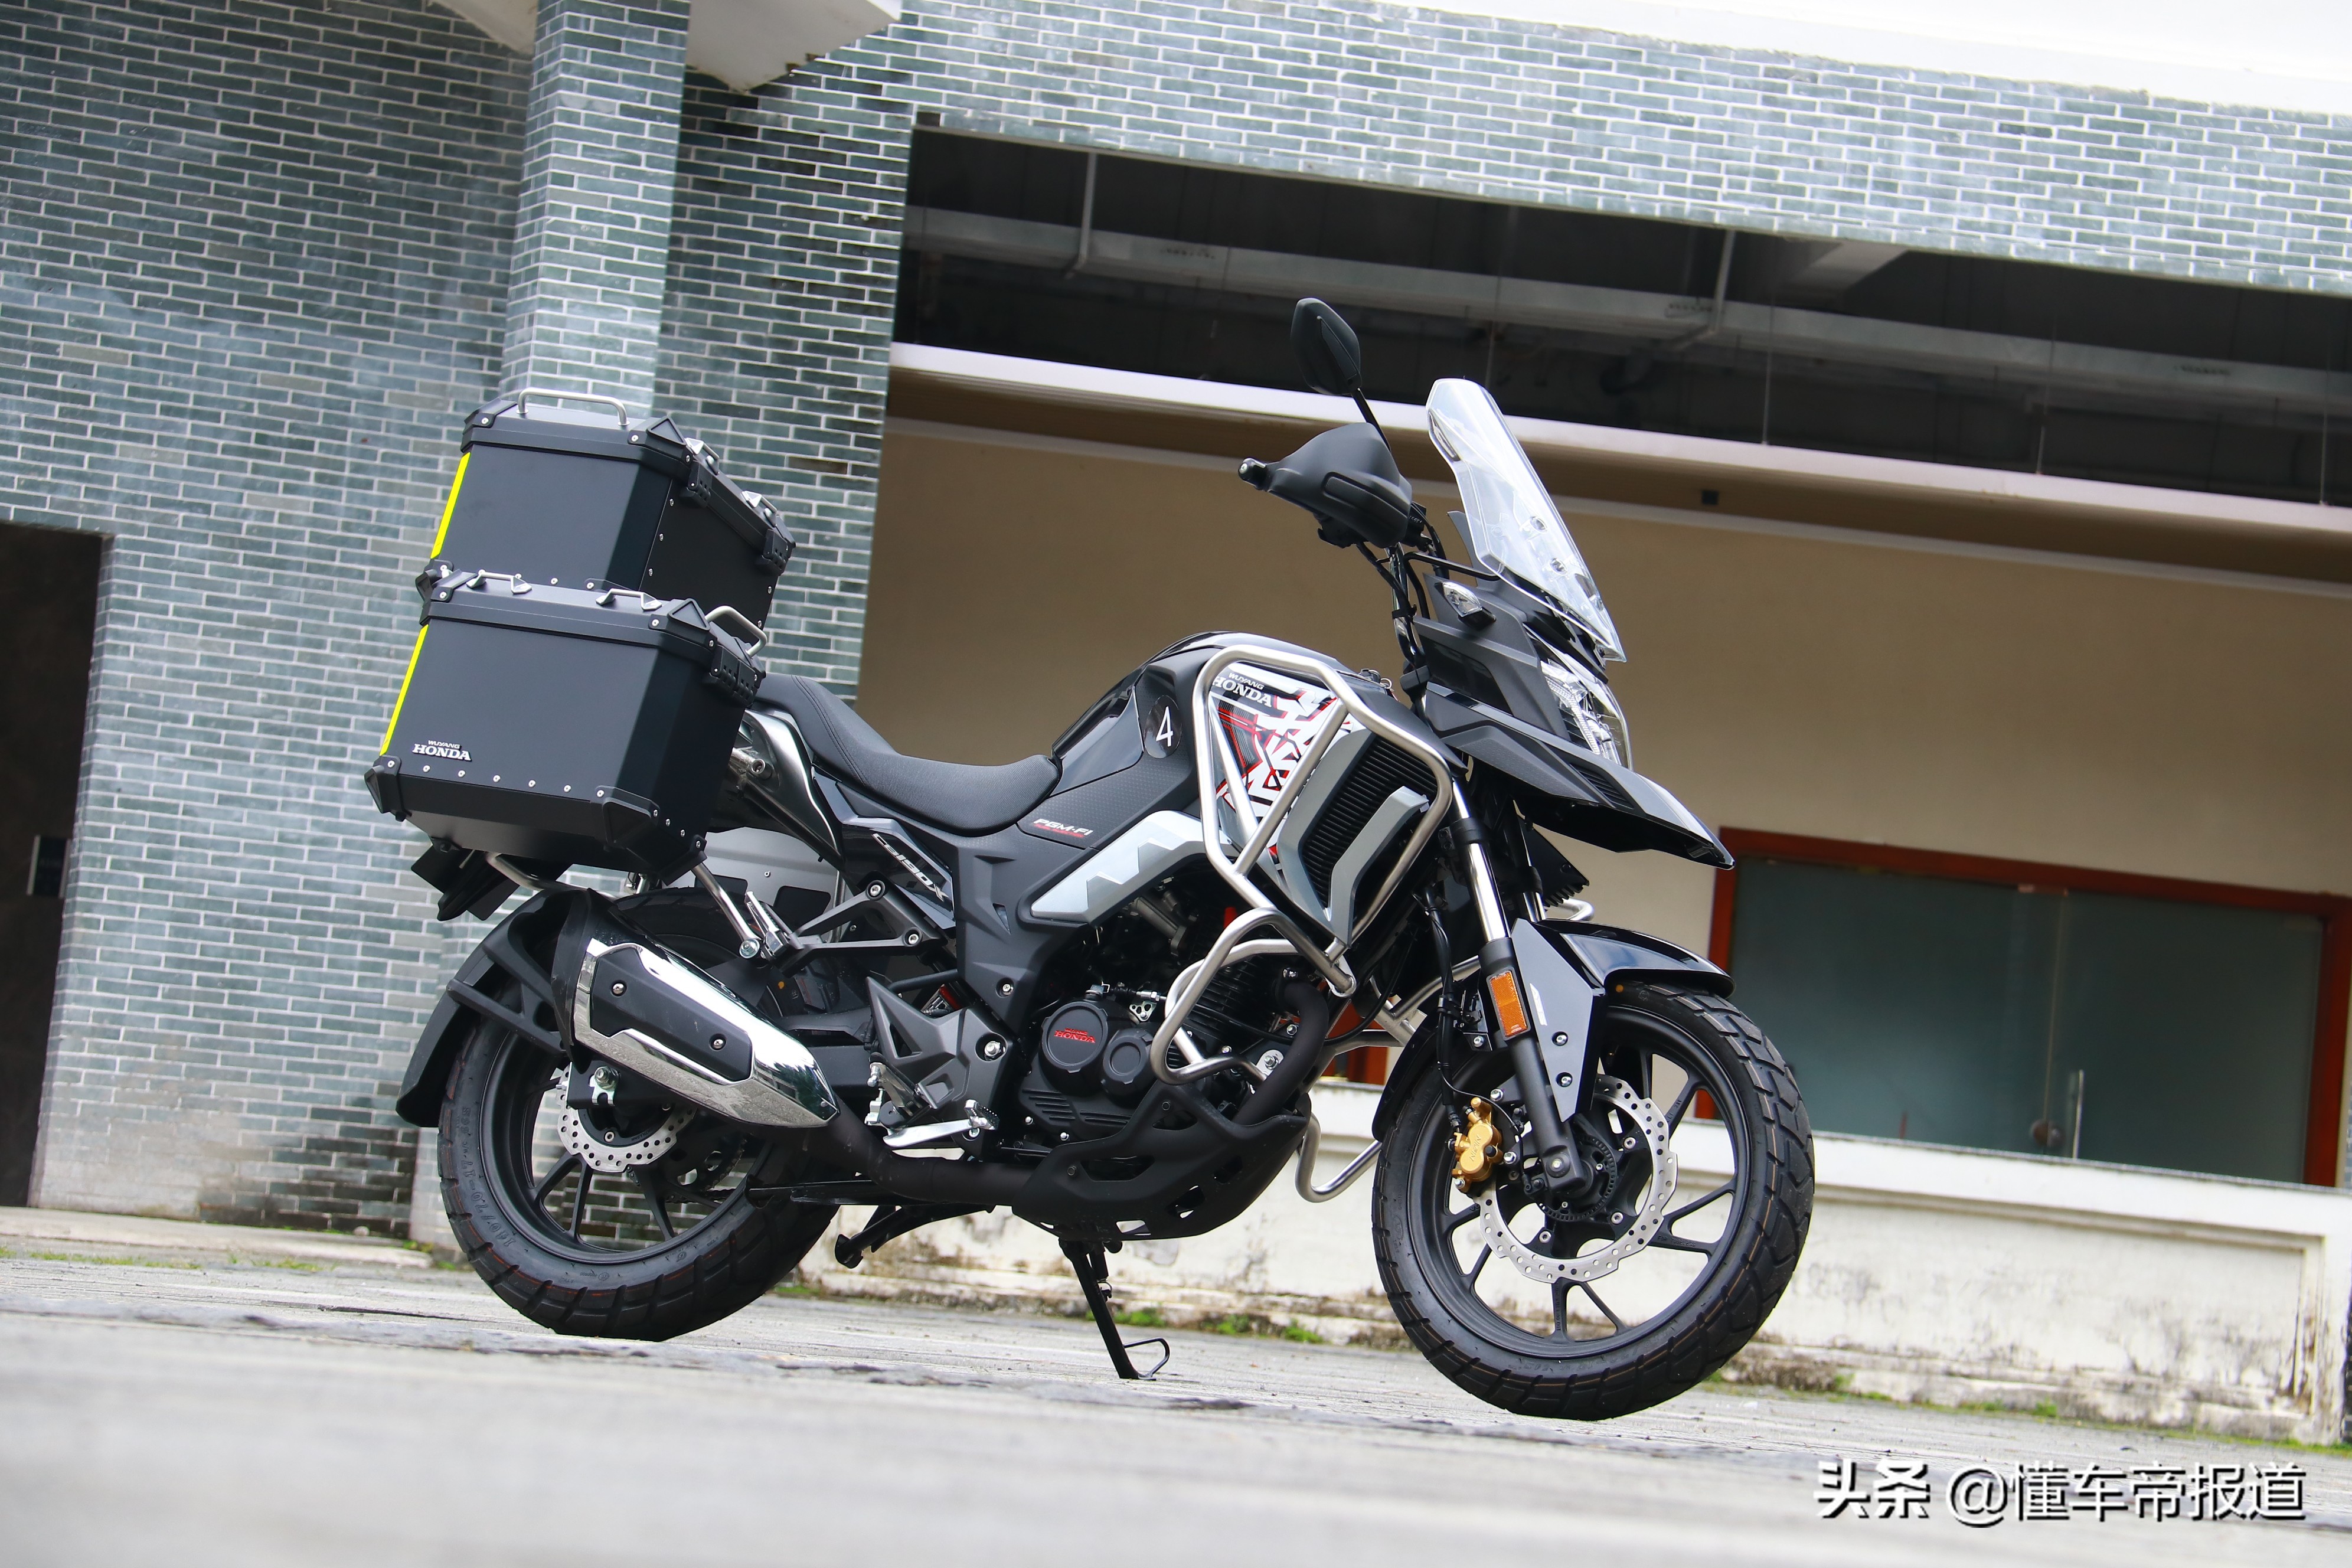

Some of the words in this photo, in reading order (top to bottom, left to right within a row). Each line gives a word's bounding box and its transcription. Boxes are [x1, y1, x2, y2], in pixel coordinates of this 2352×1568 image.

[1229, 672, 1265, 690] WUYANG
[1212, 676, 1272, 707] HONDA
[1155, 705, 1174, 747] 4
[412, 743, 471, 761] HONDA
[428, 740, 460, 749] WUYANG
[872, 833, 949, 902] CB190X
[1054, 1030, 1096, 1043] HONDA
